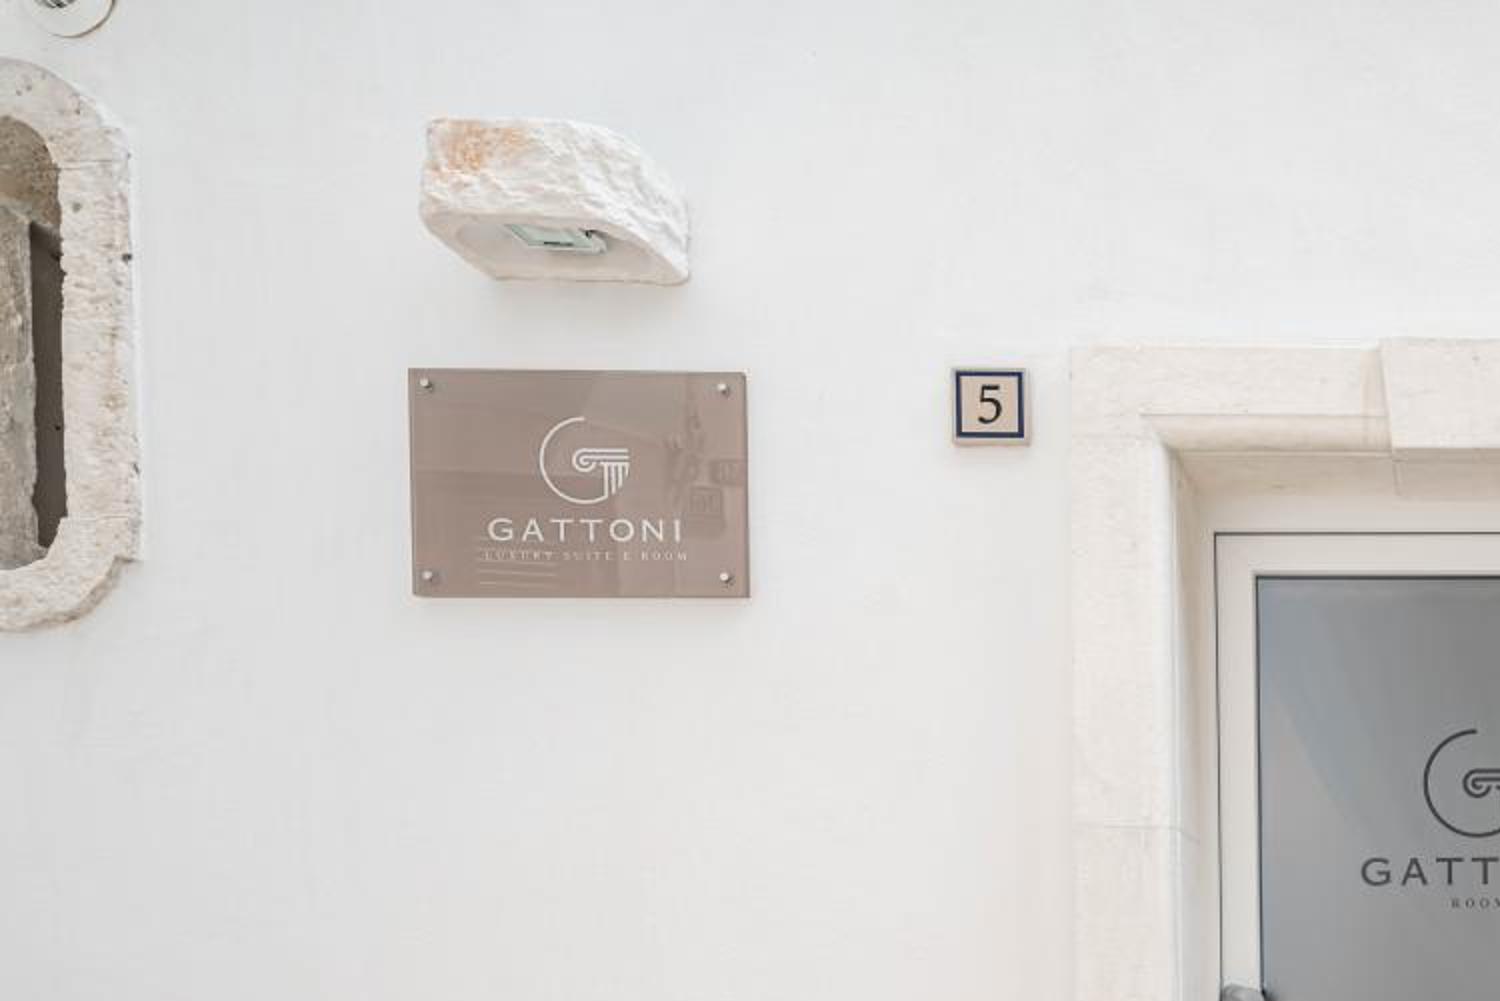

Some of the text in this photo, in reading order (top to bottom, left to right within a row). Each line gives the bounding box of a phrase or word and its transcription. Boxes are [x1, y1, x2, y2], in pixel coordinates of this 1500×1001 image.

[977, 384, 1003, 424] 5
[487, 517, 682, 543] GATTONI
[641, 551, 688, 561] ROOM
